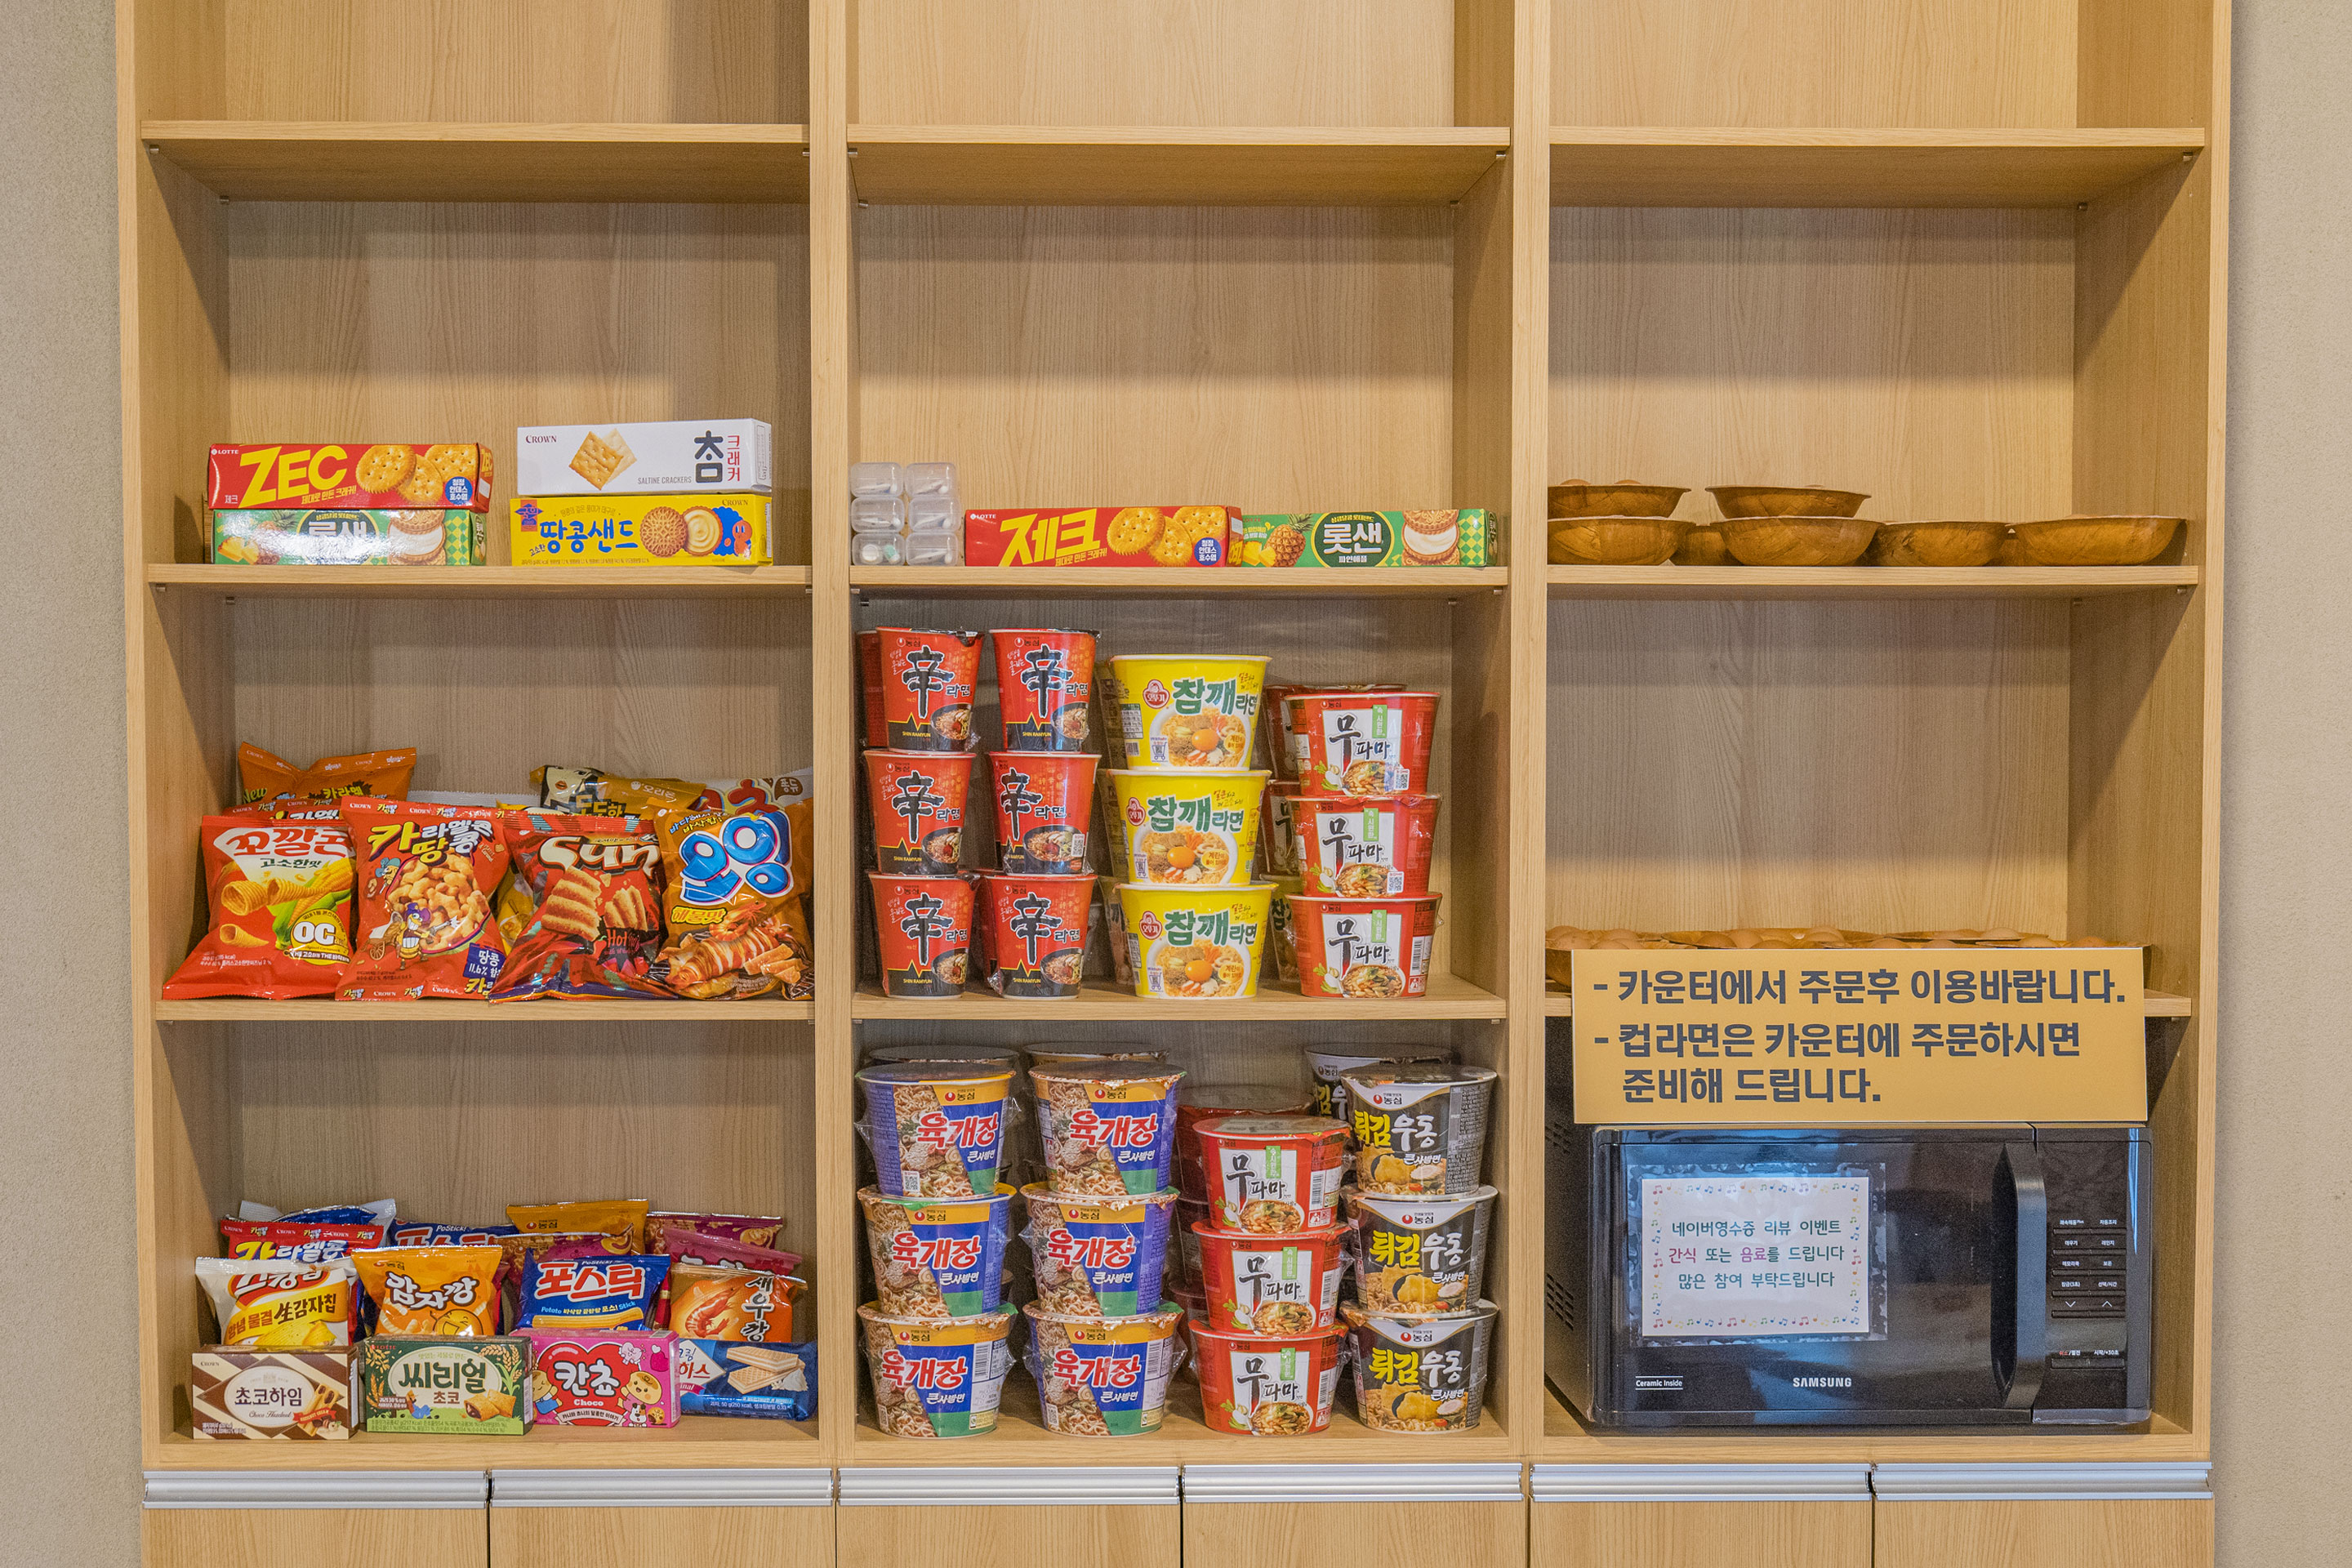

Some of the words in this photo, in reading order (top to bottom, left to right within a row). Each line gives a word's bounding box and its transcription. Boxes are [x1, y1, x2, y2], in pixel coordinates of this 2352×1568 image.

[525, 434, 557, 443] CROWN
[727, 435, 740, 482] 크래커
[238, 445, 348, 508] ZEC
[662, 476, 692, 484] CRACKERS
[225, 495, 238, 504] 제크
[539, 518, 638, 554] 땅콩샌드
[998, 509, 1100, 567] 제크
[1323, 523, 1382, 554] 롯샌
[529, 544, 546, 556] 고소한
[1172, 677, 1258, 715] 참깨라면
[1147, 795, 1244, 833] 참깨라면
[260, 858, 322, 869] 고소한맛
[670, 906, 727, 924] 해물맛
[1165, 909, 1257, 947] 참깨라면
[606, 929, 627, 947] Hot
[479, 951, 499, 967] 땅콩
[470, 964, 488, 975] 11.6%
[1618, 969, 1786, 1004] 카운터에서
[1798, 969, 1900, 1004] 주문후
[1910, 969, 2125, 1004] 이용바랍니다.
[1619, 1022, 1755, 1058] 컵라면은
[1765, 1022, 1900, 1058] 카운터에
[1912, 1022, 2080, 1058] 주문하시면
[1623, 1067, 1722, 1102] 준비해
[1735, 1067, 1881, 1102] 드립니다.
[957, 1092, 975, 1100] 농심
[1383, 1097, 1402, 1105] 농심
[916, 1111, 999, 1149] 육개장
[1069, 1108, 1159, 1147] 육개장
[967, 1149, 996, 1162] 큰사발면
[1118, 1150, 1155, 1163] 큰사발면
[1672, 1221, 1756, 1237] 네이버영수증
[1764, 1221, 1791, 1236] 리뷰
[1800, 1220, 1842, 1235] 이벤트
[892, 1232, 982, 1270] 육개장
[1047, 1228, 1137, 1269] 육개장
[1668, 1248, 1696, 1263] 간식
[1705, 1248, 1732, 1263] 또는
[1740, 1246, 1780, 1263] 음료를
[1788, 1246, 1844, 1262] 드립니다
[537, 1263, 643, 1299] 포스틱
[940, 1272, 978, 1285] 큰사발면
[1093, 1272, 1134, 1284] 큰사발면
[1678, 1273, 1706, 1290] 많은
[1714, 1273, 1742, 1289] 참여
[1751, 1272, 1834, 1288] 부탁드립니다
[386, 1272, 477, 1309] 감자깡
[619, 1301, 635, 1310] Stick
[741, 1276, 774, 1342] 새우깡
[228, 1316, 247, 1339] 양념
[248, 1312, 273, 1329] 물결
[274, 1294, 336, 1325] 生감자칩
[399, 1358, 487, 1394] 씨리얼
[881, 1349, 968, 1390] 육개장
[1053, 1348, 1142, 1388] 육개장
[553, 1358, 621, 1397] 칸쵸
[1636, 1379, 1663, 1388] Ceramic
[1664, 1379, 1682, 1387] Inside
[1793, 1377, 1852, 1388] SAMSUNG
[234, 1387, 302, 1406] 초코하임
[434, 1392, 460, 1404] 초코
[926, 1392, 965, 1405] 큰사발면
[1101, 1391, 1138, 1403] 큰사발면
[248, 1410, 265, 1419] Choco
[265, 1410, 292, 1419] Hazelnut
